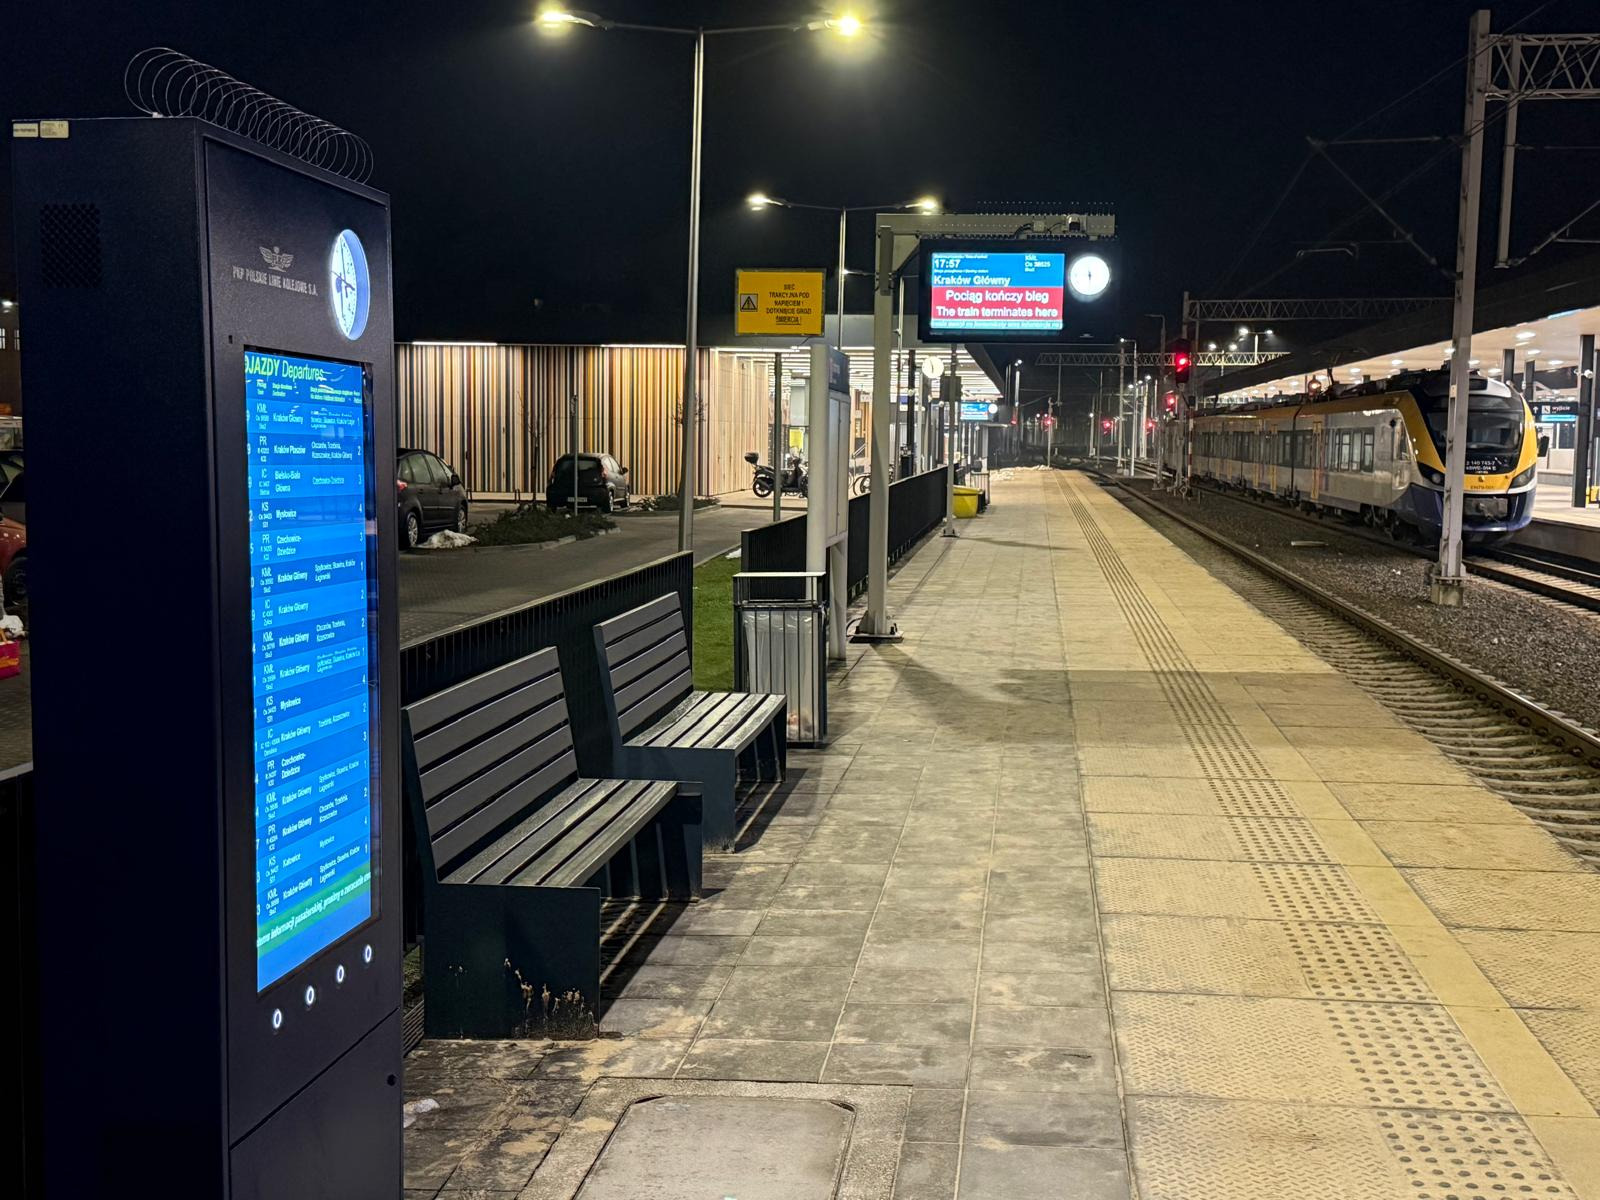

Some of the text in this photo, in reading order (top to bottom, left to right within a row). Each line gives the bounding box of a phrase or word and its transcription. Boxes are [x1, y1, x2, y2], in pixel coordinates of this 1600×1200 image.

[934, 259, 961, 268] 17:57
[232, 265, 318, 296] PKP POLSKIE LINIE KOLEJOWE S.A.
[934, 274, 1011, 288] Kraków Główny
[946, 290, 1050, 304] Pociąg kończy bieg
[936, 306, 1059, 318] The train terminates here
[281, 360, 325, 382] Departures
[259, 436, 267, 446] PR
[357, 446, 361, 456] 2
[262, 468, 268, 478] IC
[262, 502, 269, 512] KS
[262, 534, 270, 544] PR
[250, 543, 254, 554] 5
[361, 589, 364, 600] 2
[264, 600, 271, 610] IC
[362, 617, 365, 628] 2
[266, 696, 274, 707] KS
[267, 728, 274, 739] IC
[267, 760, 275, 771] PR
[268, 824, 276, 836] PR
[271, 916, 296, 940] informacji
